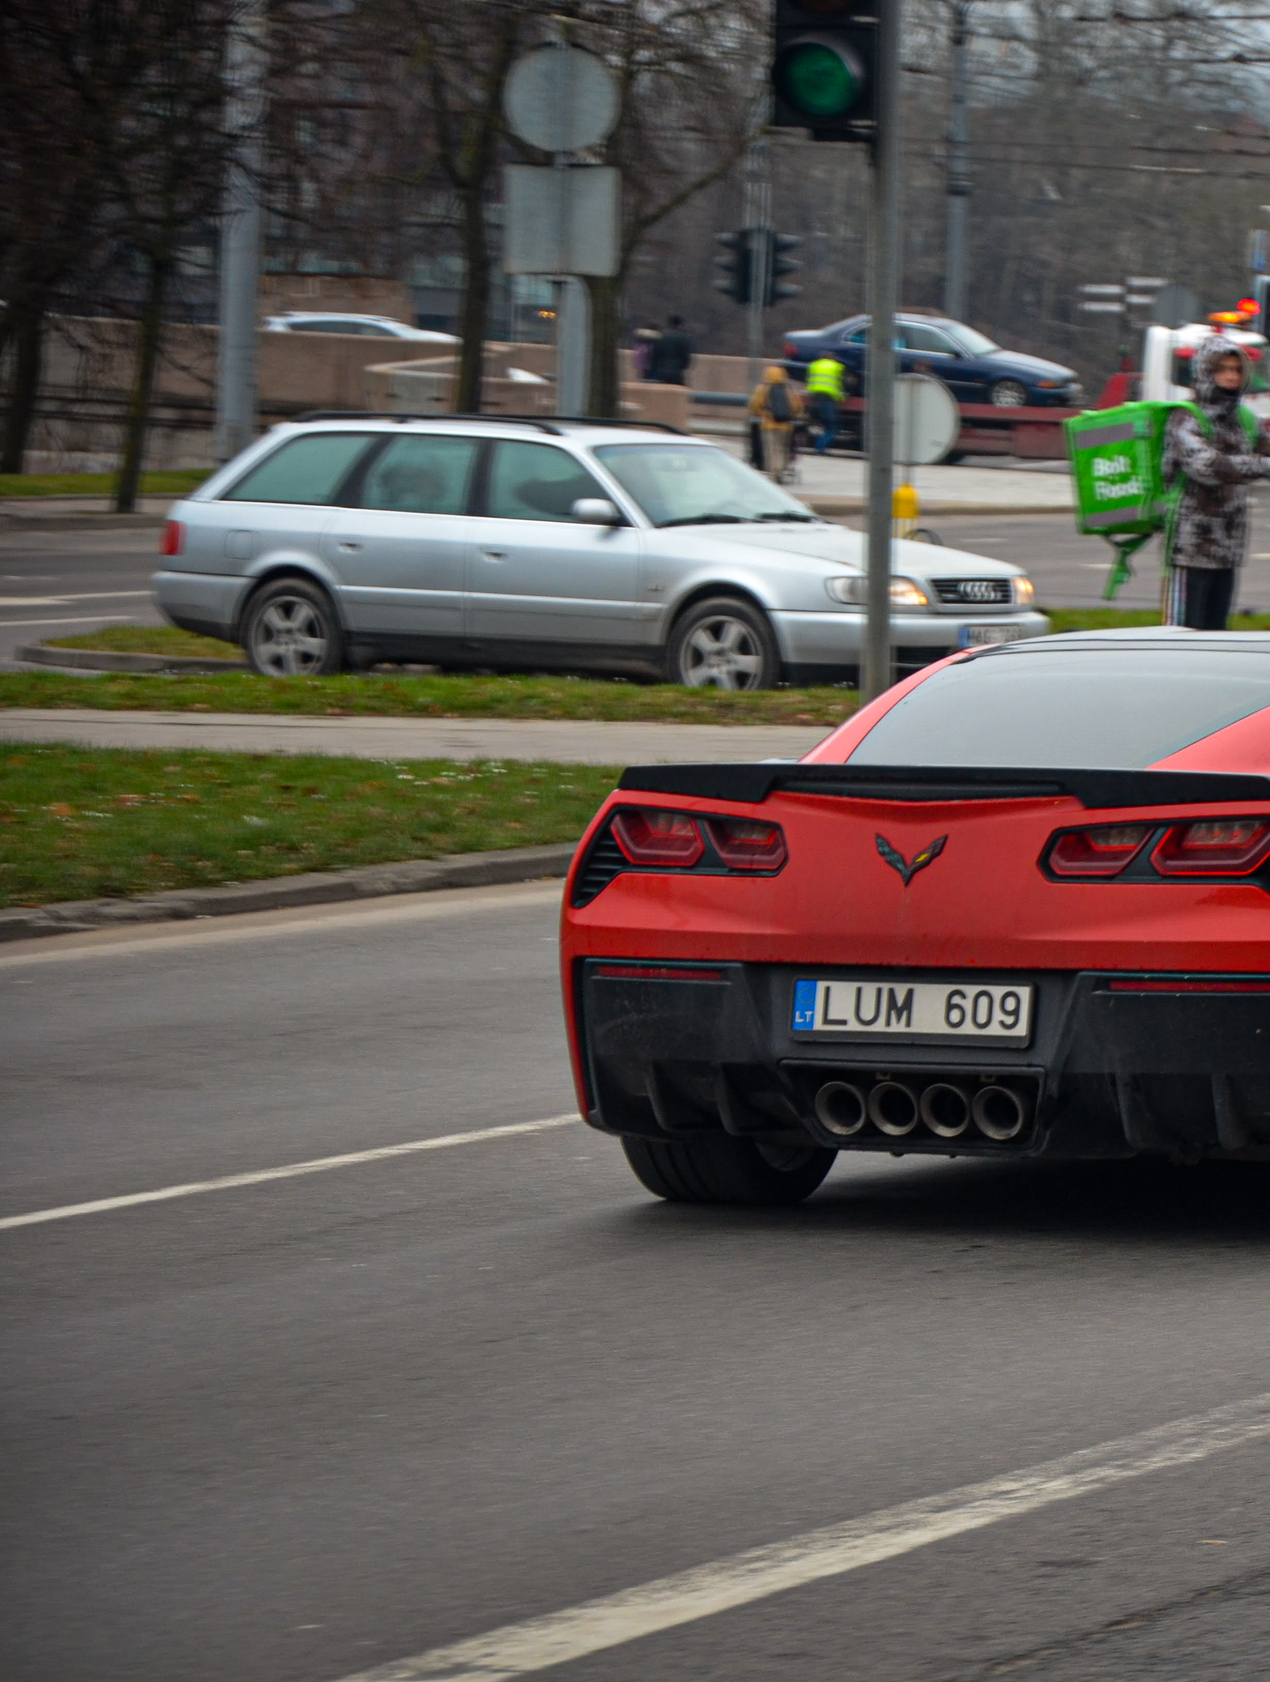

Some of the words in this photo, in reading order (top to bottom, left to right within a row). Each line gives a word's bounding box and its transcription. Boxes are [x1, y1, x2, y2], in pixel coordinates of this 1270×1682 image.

[795, 1010, 813, 1023] LT
[821, 985, 915, 1028] LUM
[943, 988, 1021, 1030] 609
